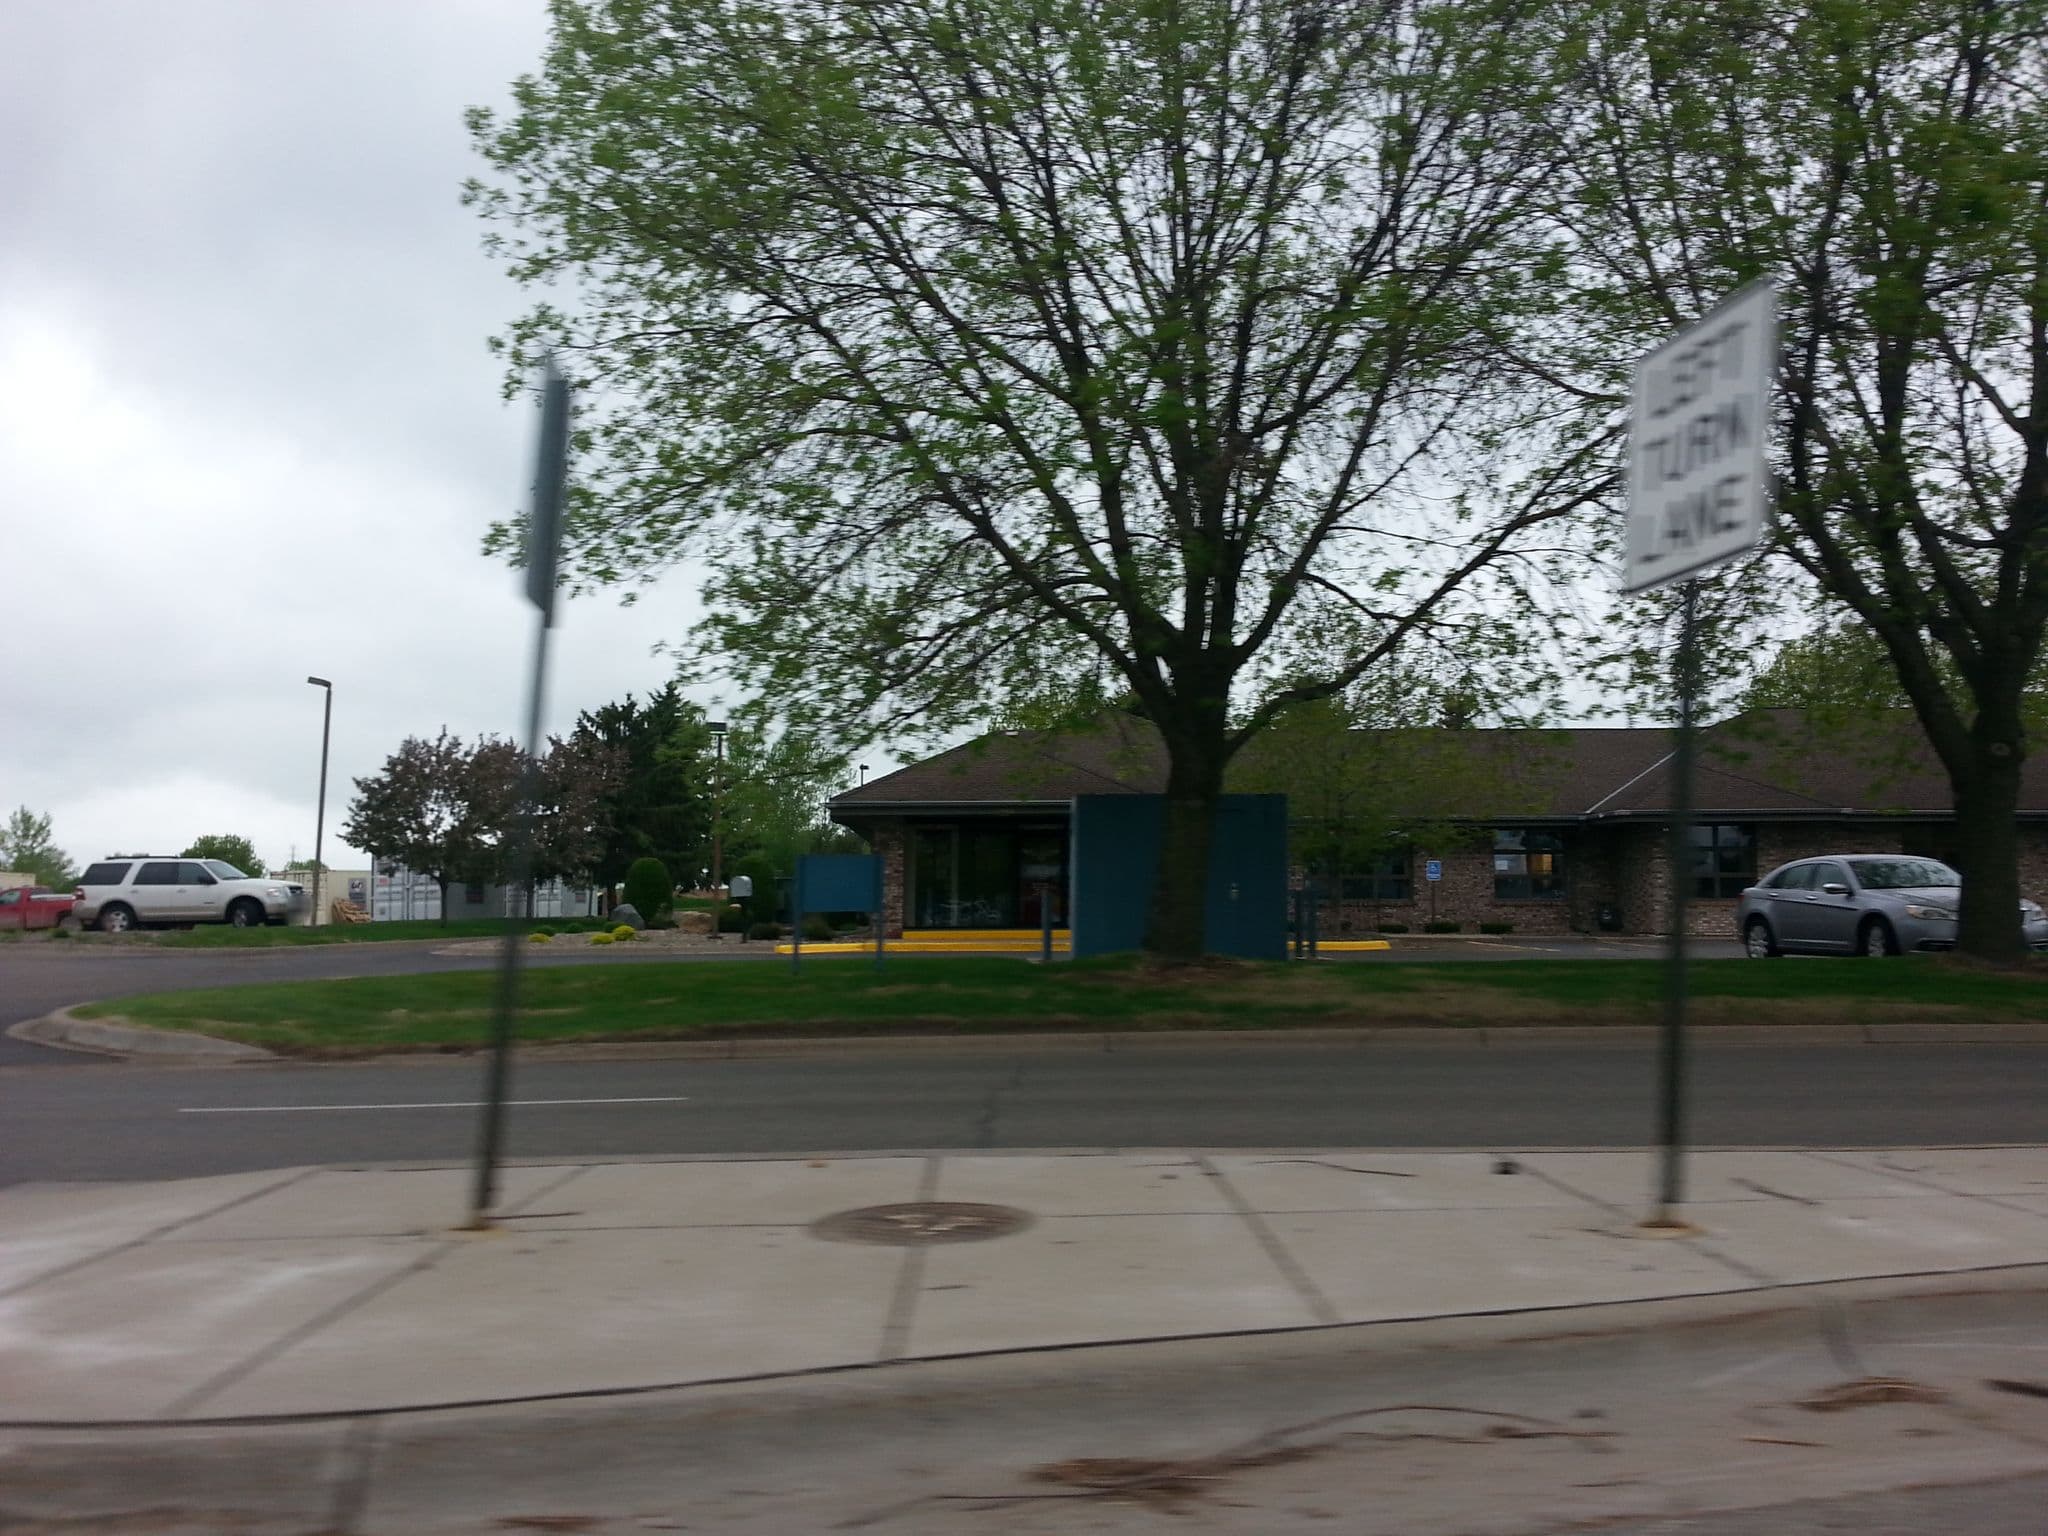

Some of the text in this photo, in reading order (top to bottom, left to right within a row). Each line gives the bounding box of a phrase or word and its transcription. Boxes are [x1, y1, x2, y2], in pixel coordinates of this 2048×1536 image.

[1645, 320, 1750, 419] LEFT
[1640, 394, 1755, 491] TURN
[1634, 472, 1750, 565] LANE
